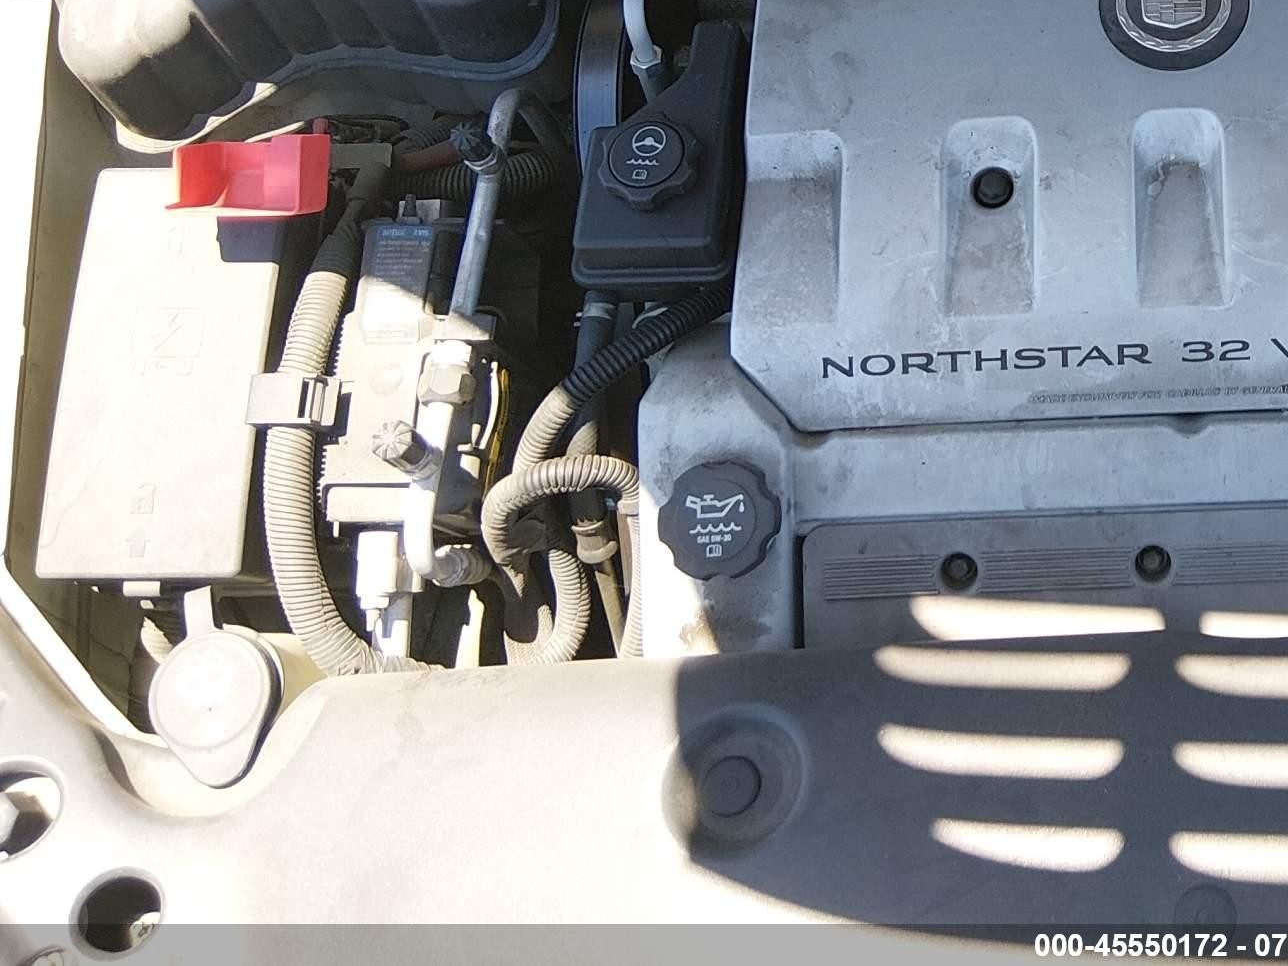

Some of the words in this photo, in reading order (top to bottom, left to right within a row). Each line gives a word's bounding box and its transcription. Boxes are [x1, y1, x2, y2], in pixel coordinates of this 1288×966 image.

[820, 342, 1153, 379] NORTHSTAR
[1181, 339, 1252, 363] 32
[697, 534, 710, 544] SAE
